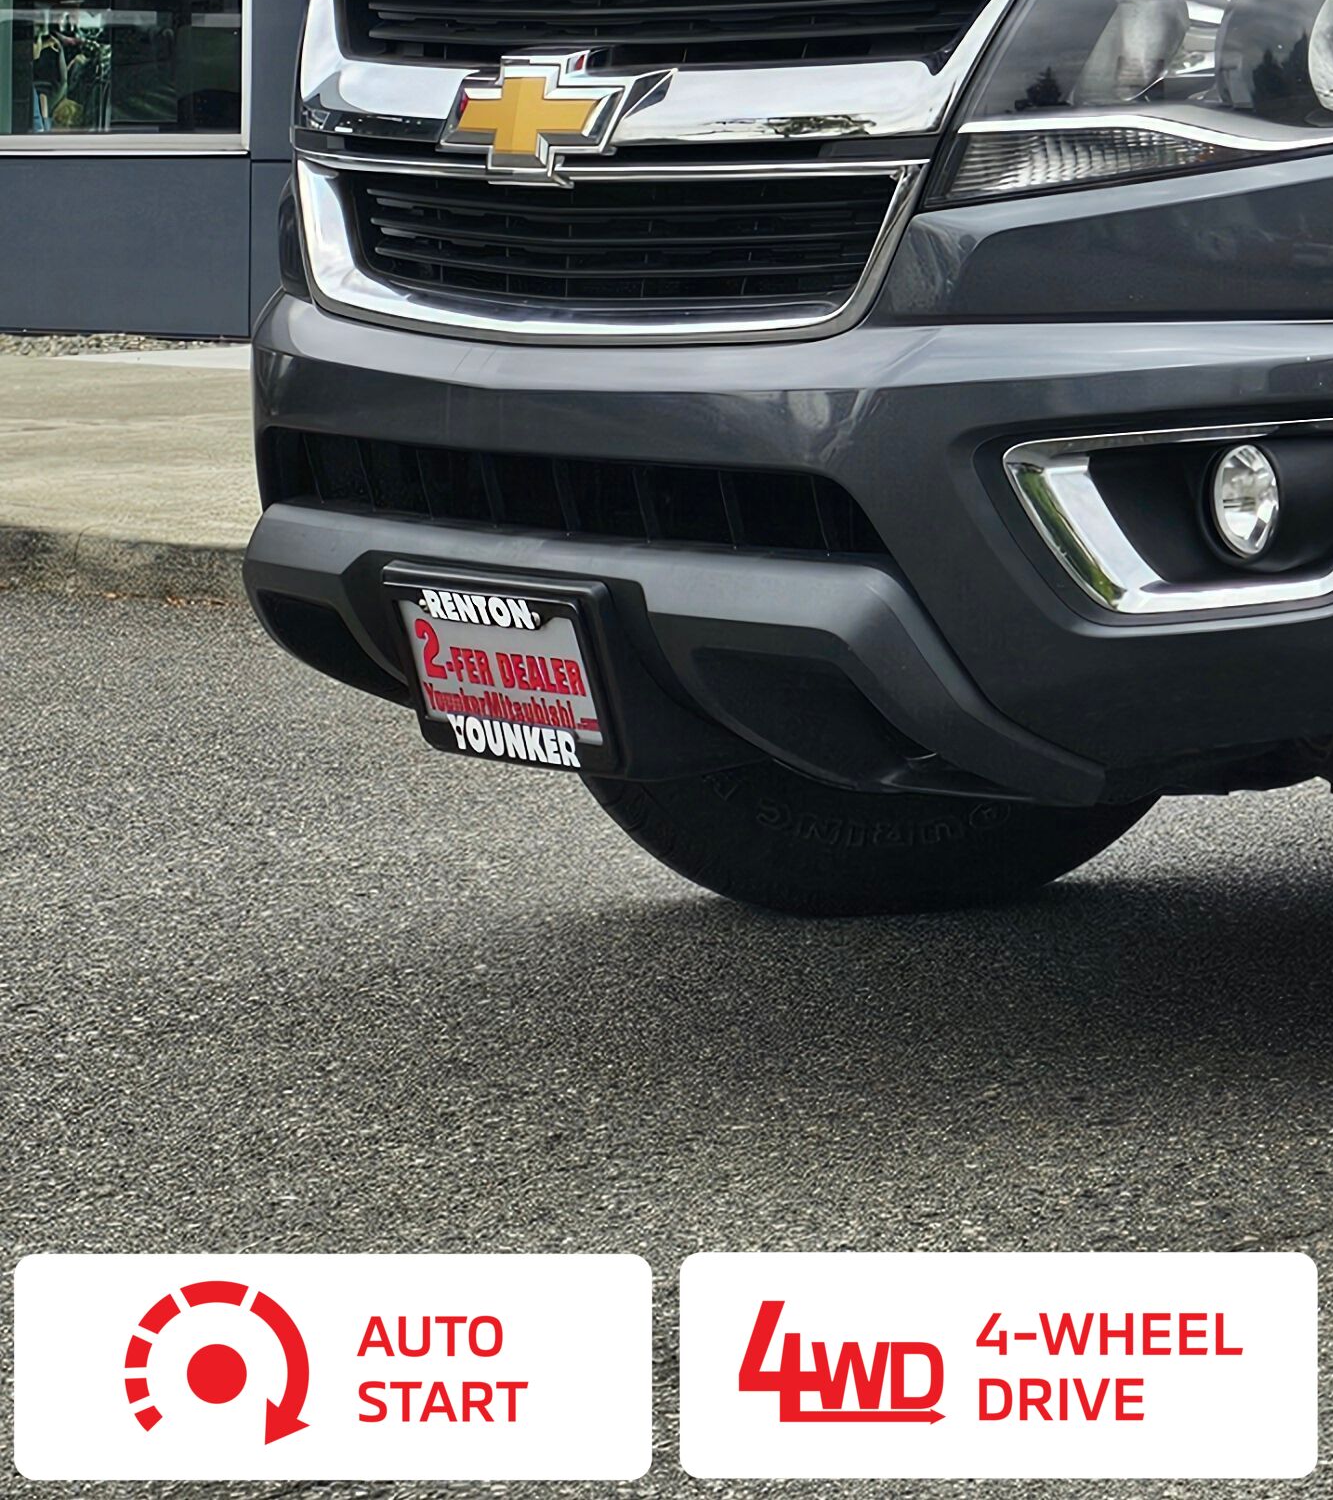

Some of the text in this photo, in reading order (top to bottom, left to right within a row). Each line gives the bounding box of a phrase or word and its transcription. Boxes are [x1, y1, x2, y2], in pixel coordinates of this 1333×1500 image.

[422, 589, 536, 630] RENTON
[414, 618, 587, 697] 2-FER DEALER
[446, 713, 582, 768] YOUNKER
